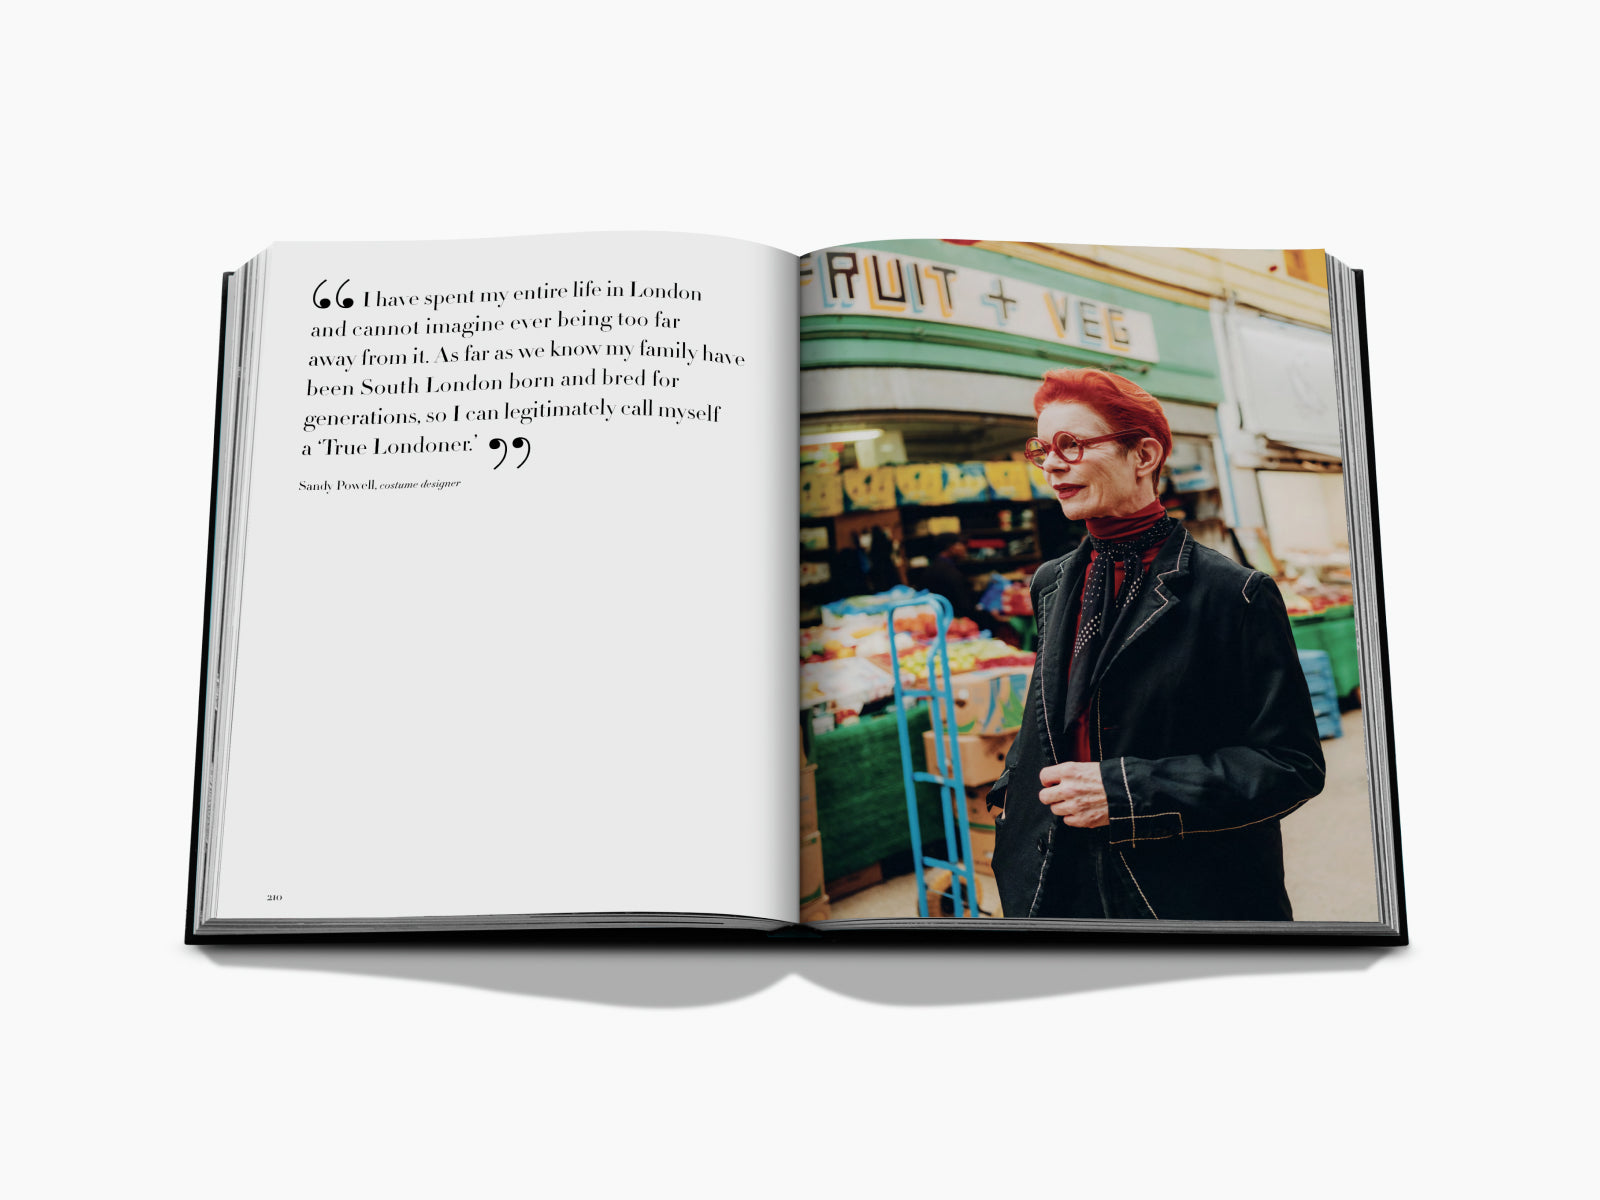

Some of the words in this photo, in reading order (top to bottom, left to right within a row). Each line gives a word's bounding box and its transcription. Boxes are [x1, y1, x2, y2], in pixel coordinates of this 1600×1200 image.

[364, 291, 370, 308] I
[377, 291, 419, 308] have
[424, 290, 474, 312] spent
[480, 291, 508, 309] my
[514, 283, 568, 301] entire
[573, 280, 601, 298] life
[607, 280, 624, 297] in
[630, 281, 701, 302] London
[311, 320, 346, 338] and
[353, 321, 418, 337] cannot
[426, 315, 504, 339] imagine
[511, 318, 552, 331] ever
[558, 309, 613, 333] being
[617, 313, 648, 327] too
[655, 311, 680, 329] far
[1044, 293, 1130, 350] VEG
[309, 355, 356, 373] away
[362, 349, 406, 366] from
[413, 347, 429, 365] it.
[434, 346, 458, 364] As
[464, 344, 490, 362] far
[495, 349, 513, 361] as
[518, 347, 544, 359] we
[550, 340, 602, 358] know
[606, 345, 634, 363] my
[640, 339, 698, 367] family
[703, 344, 745, 367] have
[307, 379, 353, 397] been
[361, 377, 419, 396] South
[426, 374, 502, 394] London
[510, 372, 554, 390] born
[561, 368, 595, 387] and
[602, 368, 645, 387] bred
[653, 370, 679, 388] for
[303, 408, 420, 433] generations,
[426, 412, 446, 423] so
[453, 405, 459, 422] I
[466, 410, 498, 422] can
[504, 398, 615, 425] legitimately
[621, 399, 652, 417] call
[659, 404, 721, 425] myself
[302, 445, 311, 456] a
[299, 480, 331, 495] Sandy
[420, 480, 462, 491] designer
